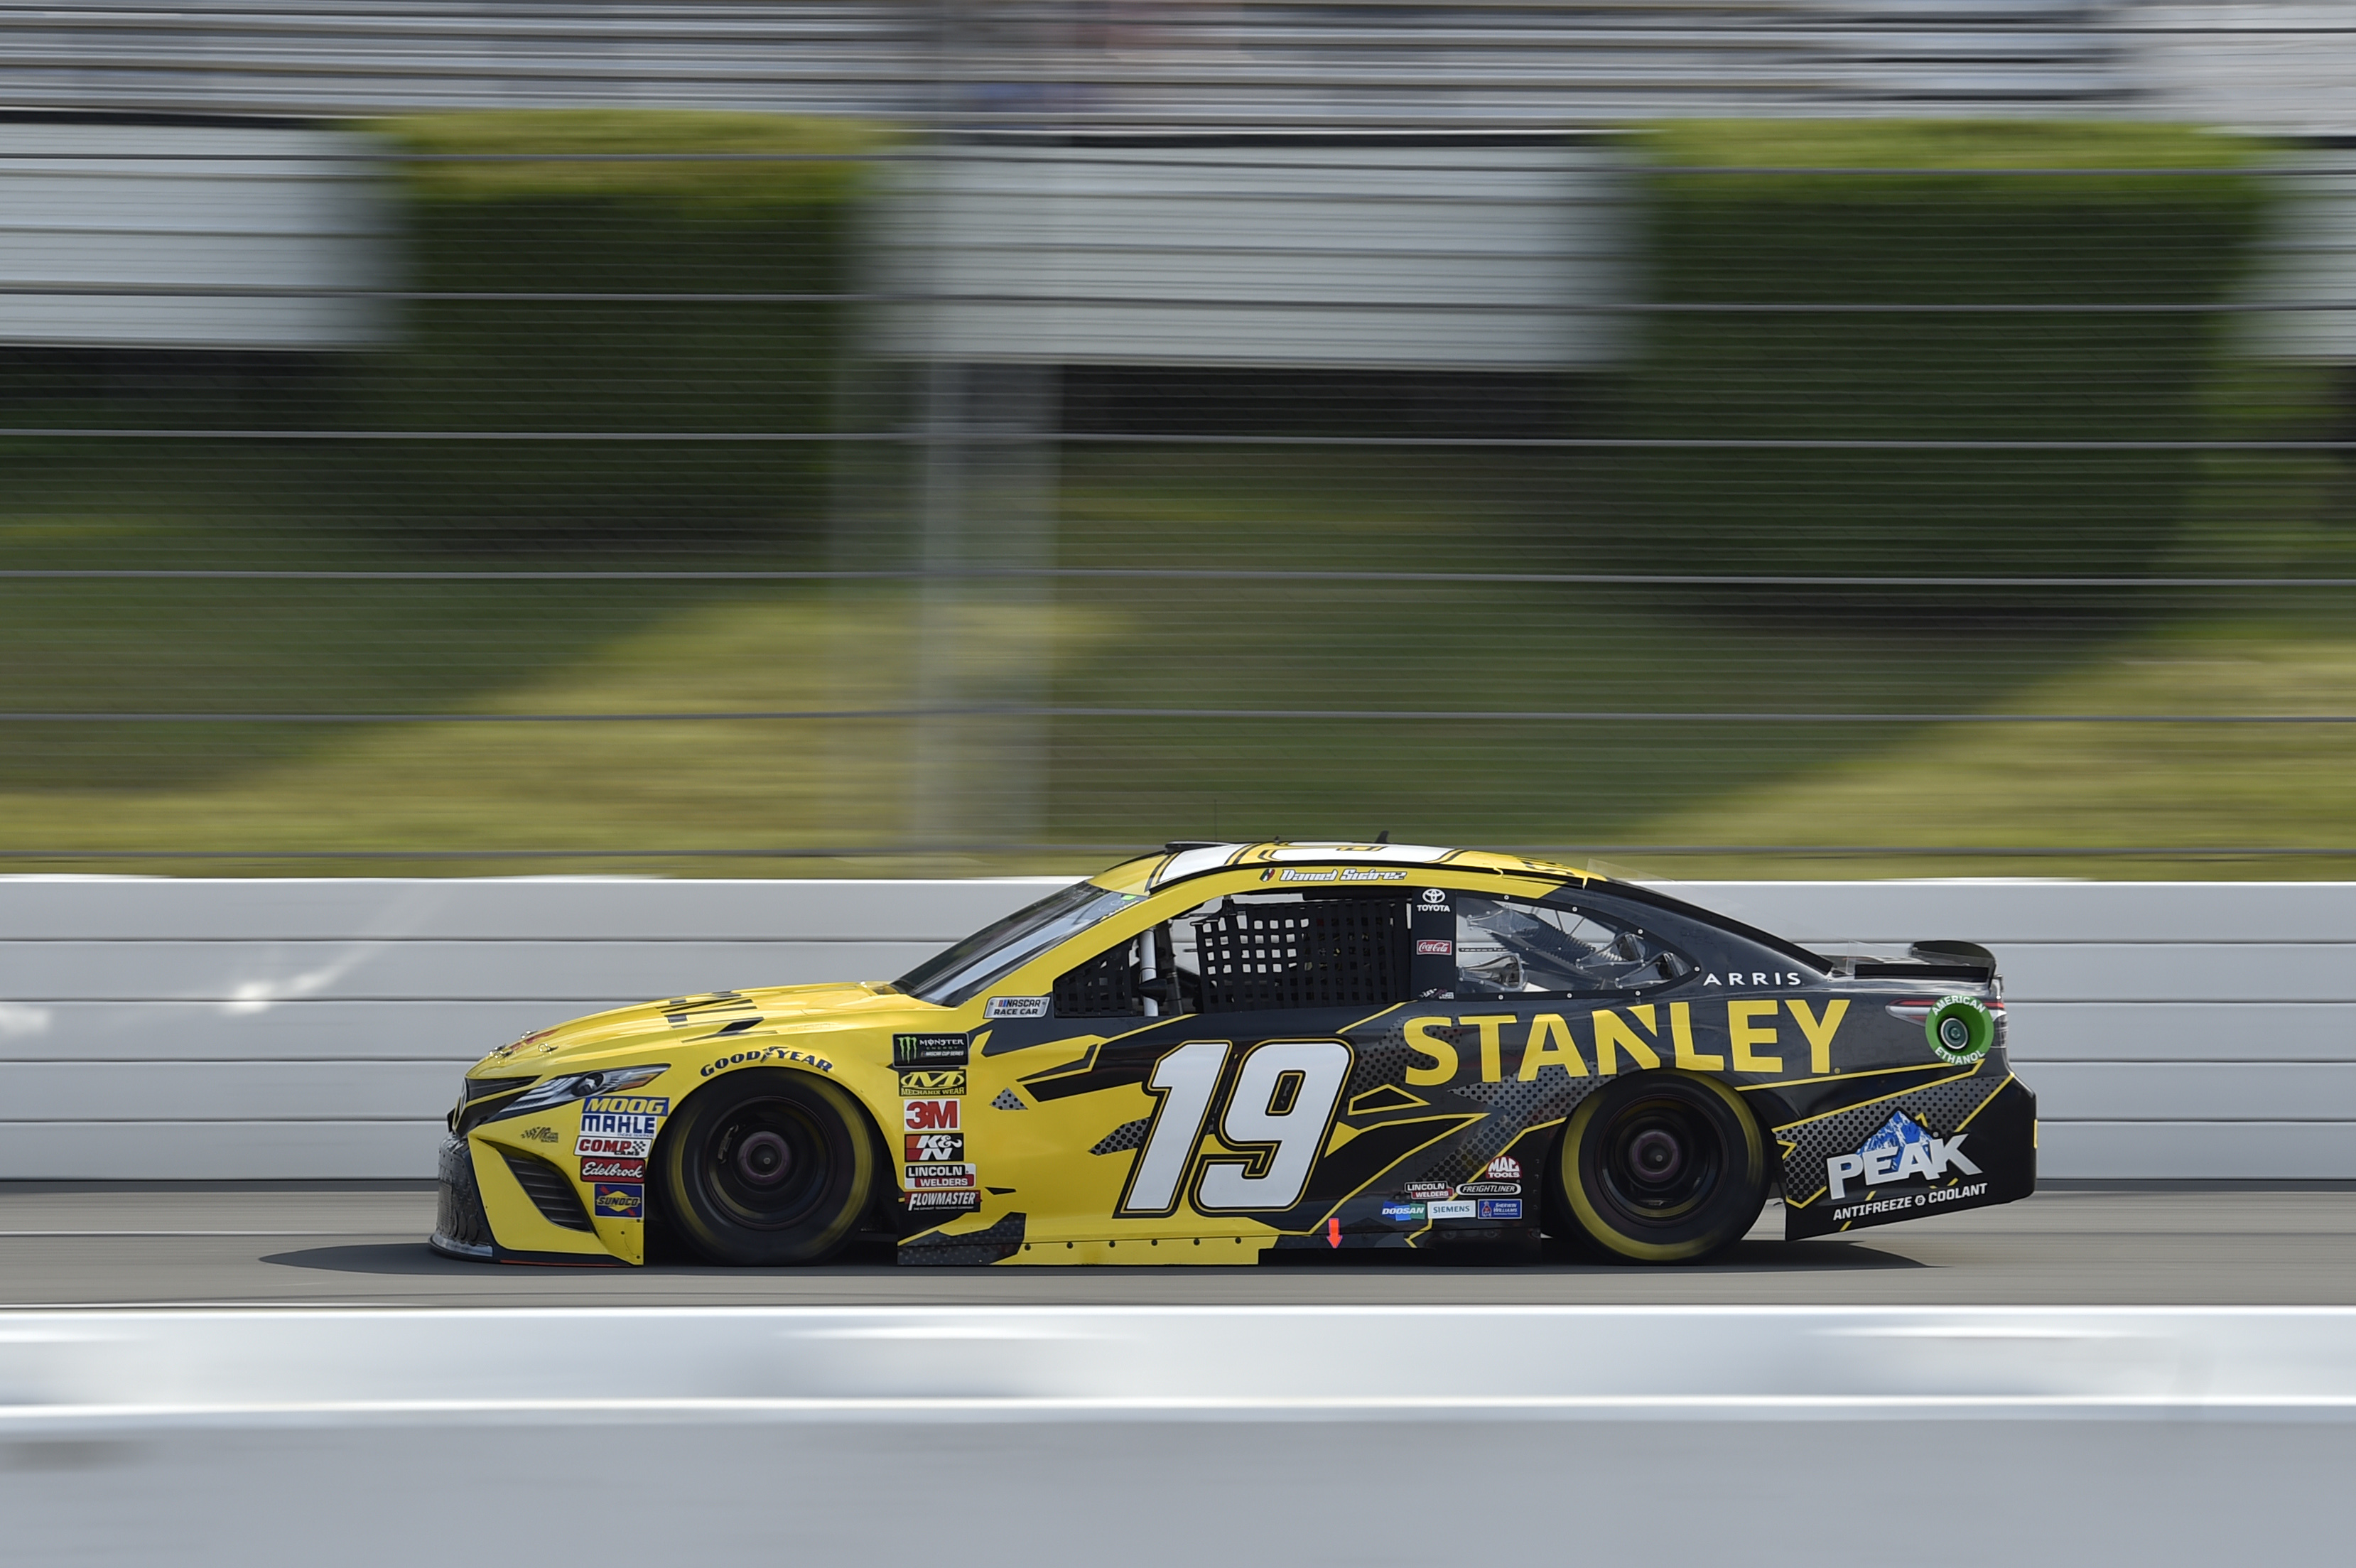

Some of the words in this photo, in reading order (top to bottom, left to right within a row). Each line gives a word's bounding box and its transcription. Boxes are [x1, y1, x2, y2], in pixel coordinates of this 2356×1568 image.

[1703, 972, 1801, 986] ARRIS
[1006, 999, 1042, 1007] NASCAR
[1932, 995, 1987, 1016] AMERICAN
[1403, 999, 1851, 1086] STANLEY
[1934, 1046, 1986, 1065] ETHANOL
[585, 1098, 666, 1114] MOOG
[581, 1115, 655, 1134] MAHLE
[906, 1101, 958, 1130] 3M
[1120, 1038, 1354, 1212] 19
[579, 1139, 632, 1152] COMP
[582, 1161, 643, 1178] Edelbrock
[908, 1166, 963, 1177] LINCOLN
[1488, 1157, 1520, 1172] MAC
[1827, 1133, 1984, 1201] PEAK
[920, 1178, 968, 1186] WELDERS
[598, 1197, 639, 1206] SUNOCO
[908, 1192, 976, 1211] FLOWMASTER
[1833, 1196, 1912, 1221] ANTIFREEZE
[1928, 1182, 1988, 1204] COOLANT
